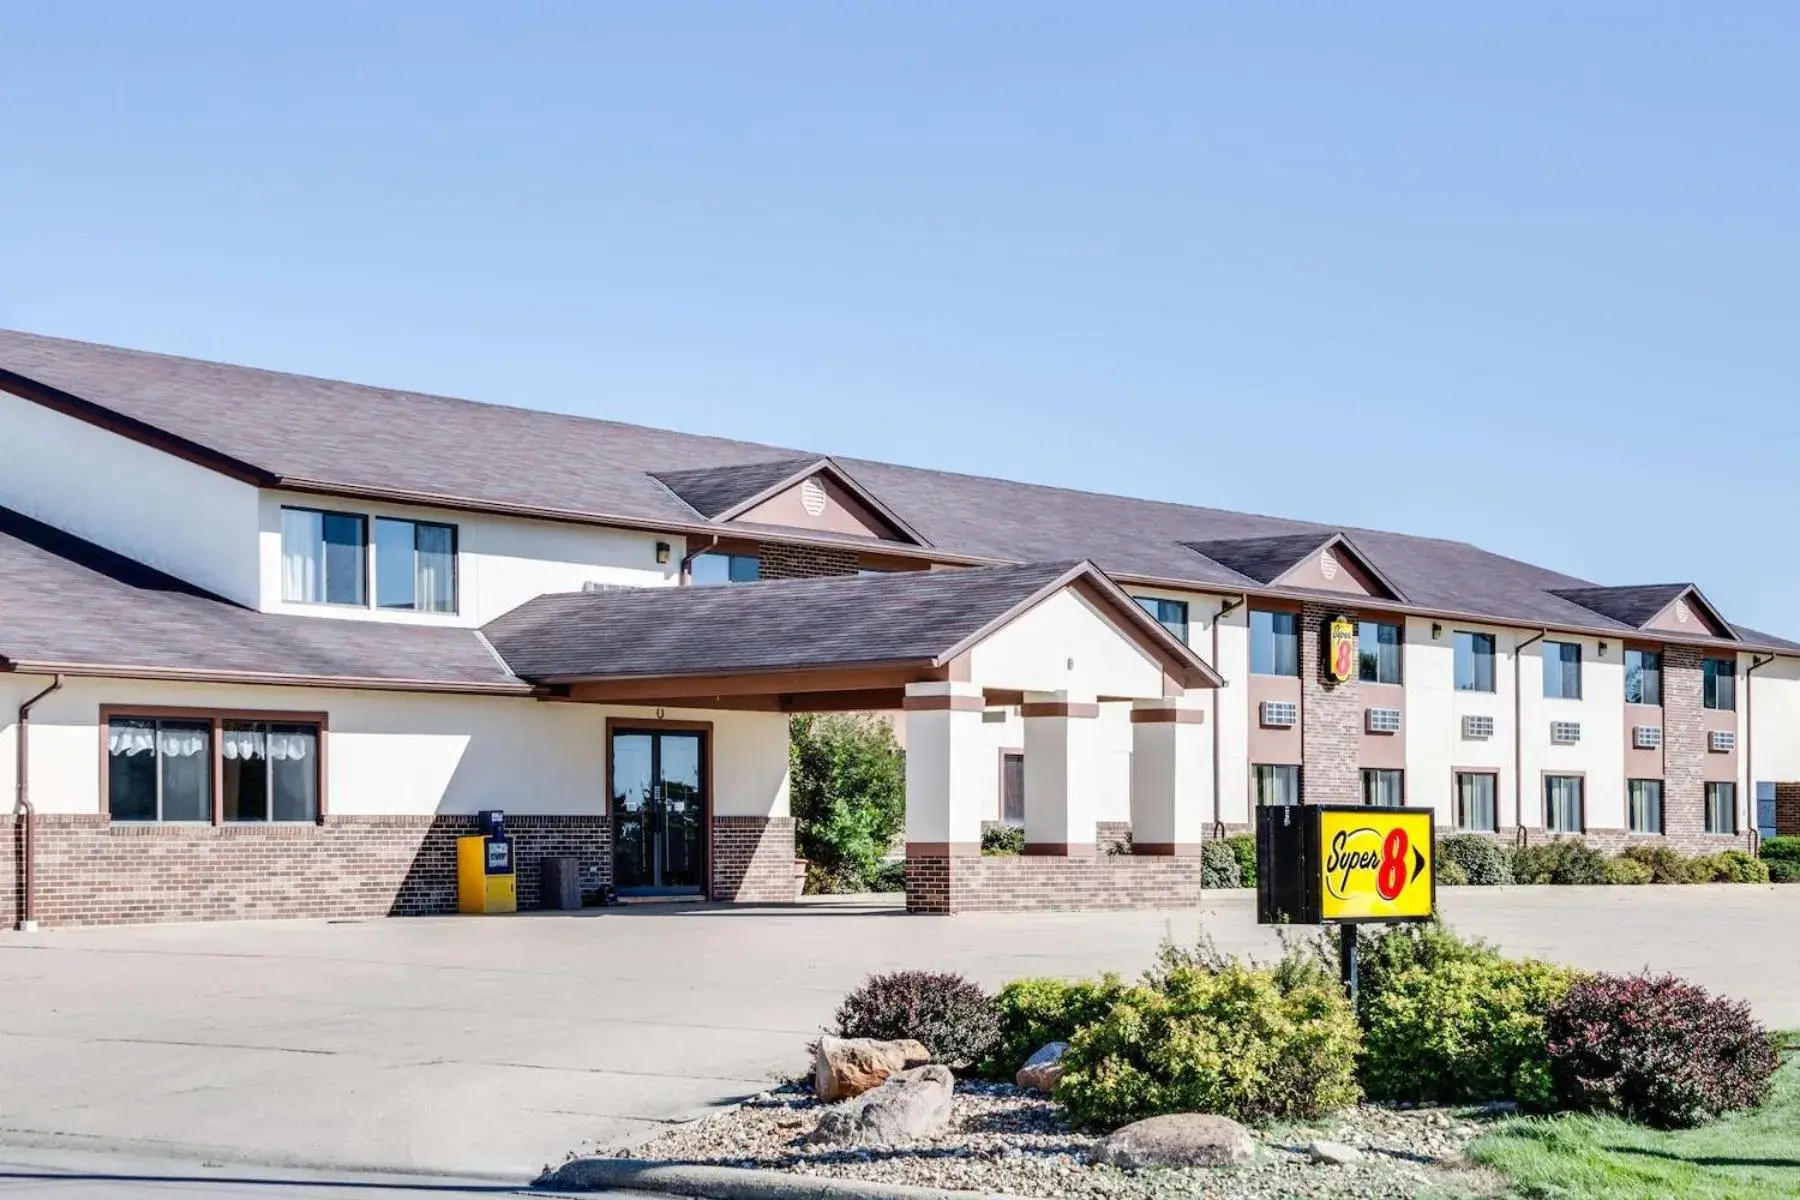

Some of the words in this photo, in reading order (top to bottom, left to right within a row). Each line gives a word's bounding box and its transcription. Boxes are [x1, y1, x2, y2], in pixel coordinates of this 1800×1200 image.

[1332, 624, 1351, 644] Super
[1337, 640, 1351, 676] 8
[1326, 830, 1380, 892] Super
[1377, 827, 1408, 900] 8
